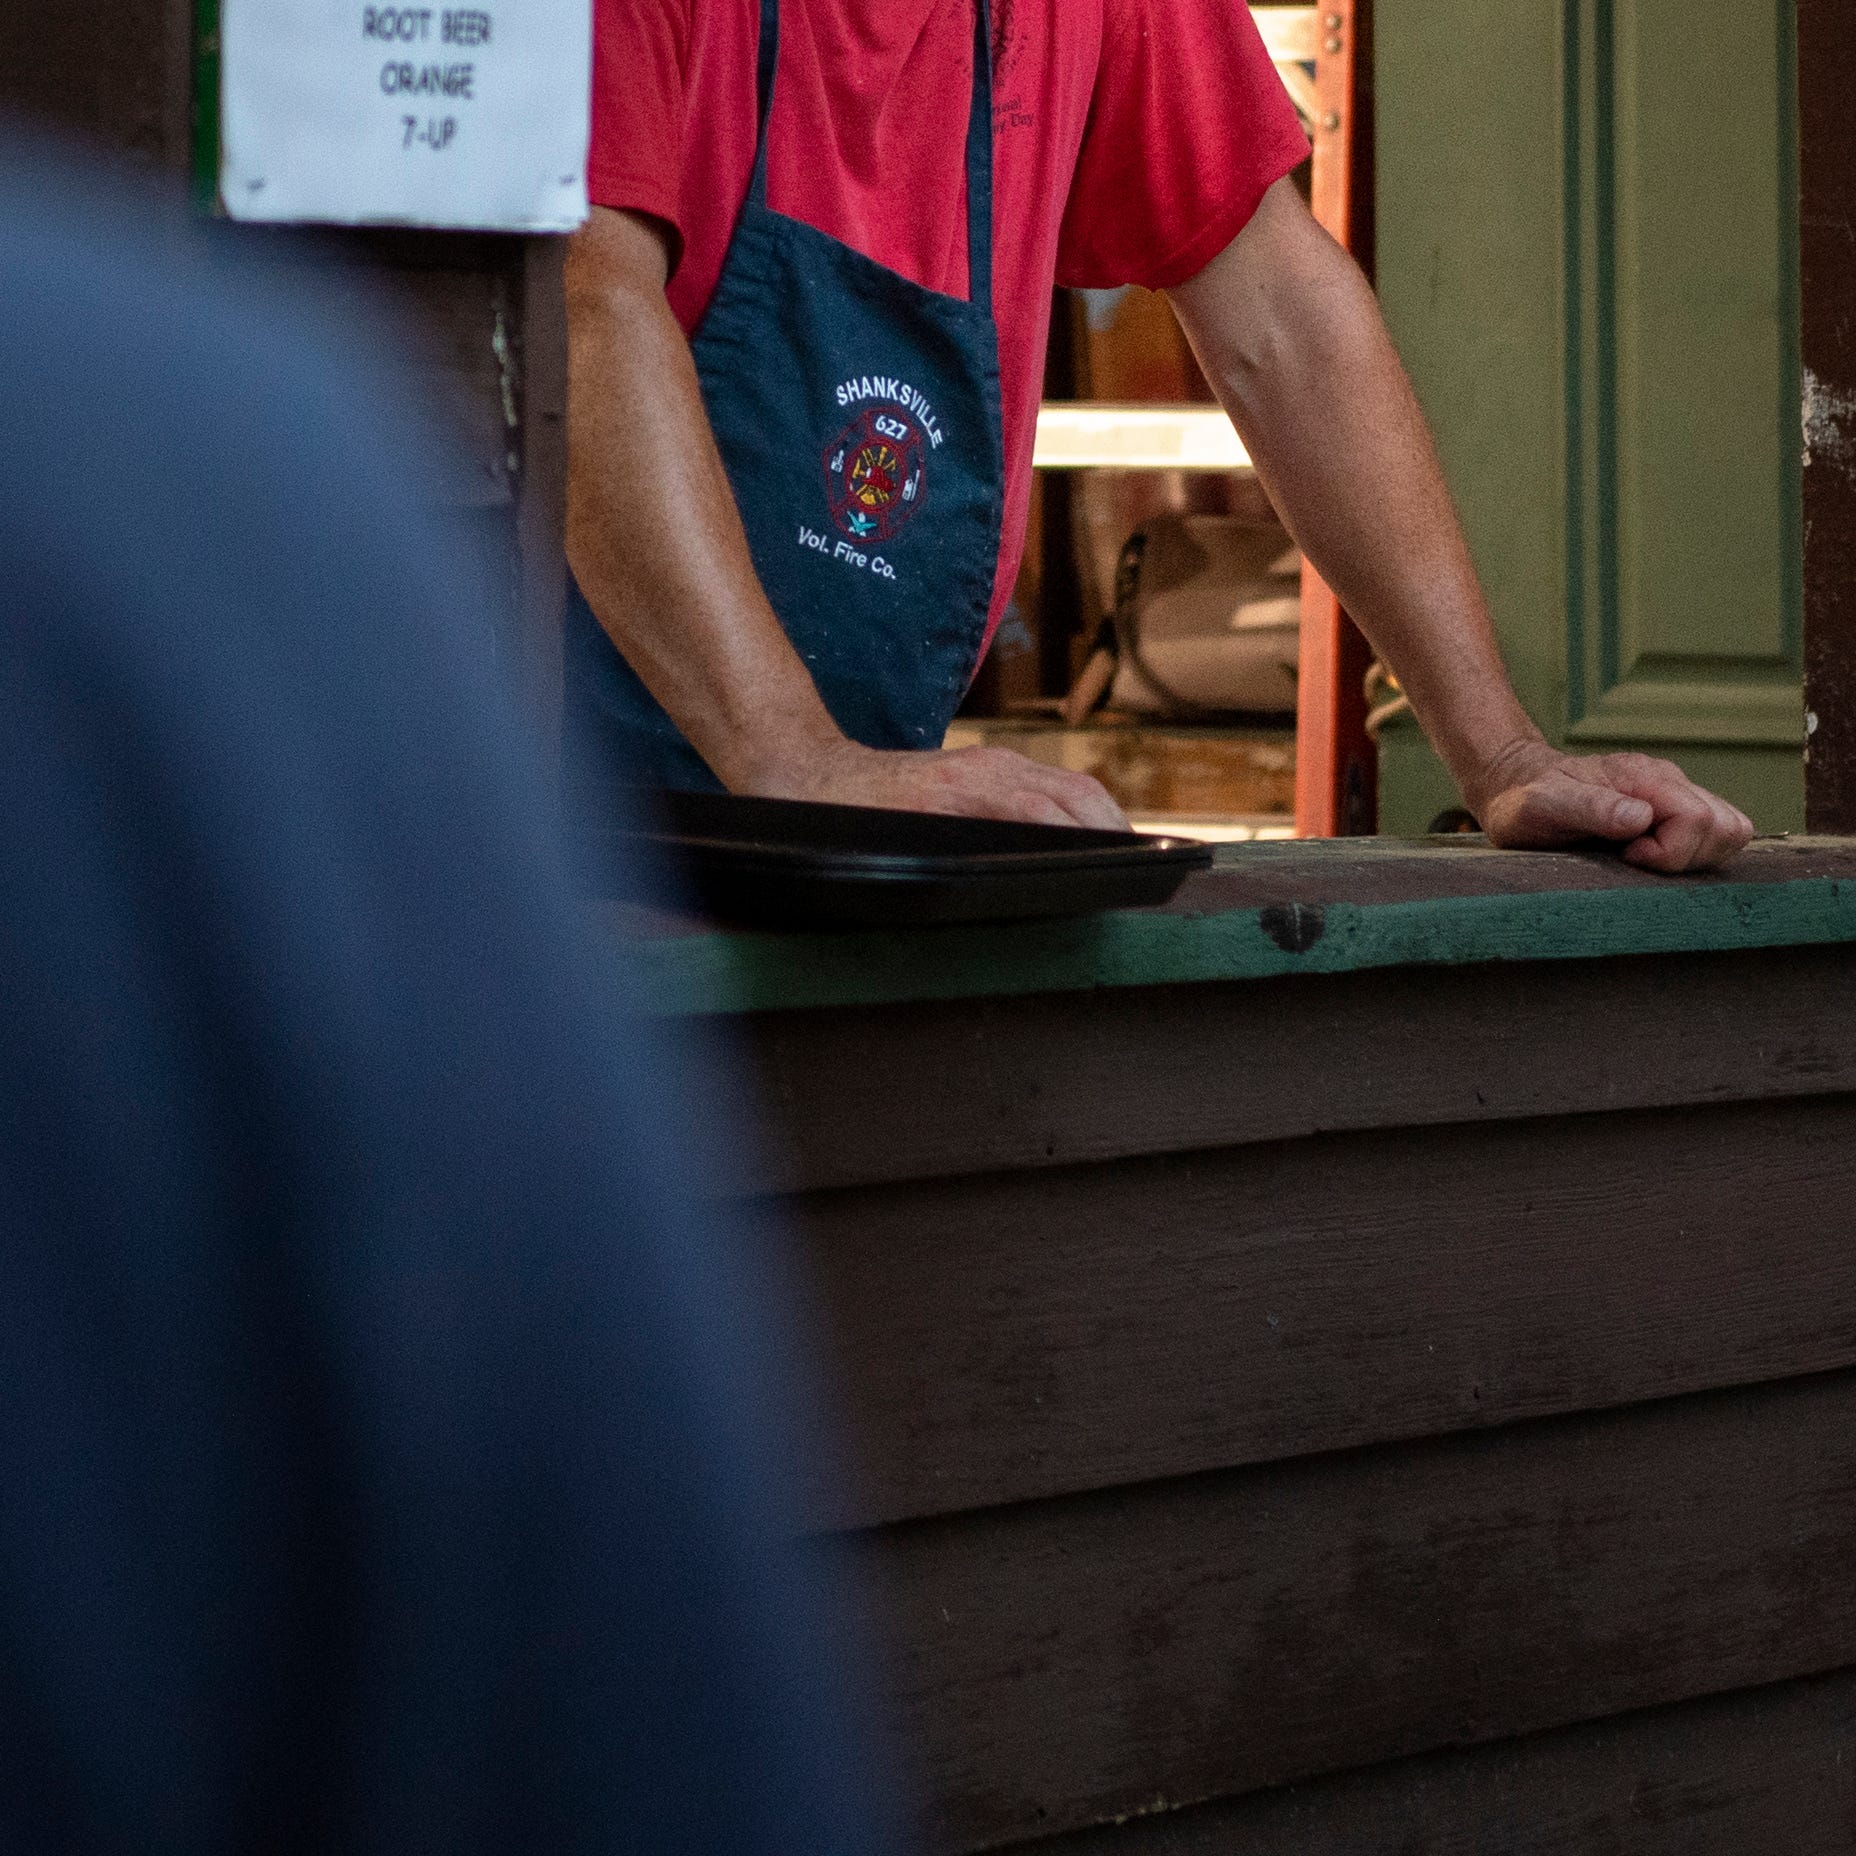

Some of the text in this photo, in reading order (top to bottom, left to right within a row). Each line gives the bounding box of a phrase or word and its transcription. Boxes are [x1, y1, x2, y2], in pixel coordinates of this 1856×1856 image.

[362, 6, 492, 46] ROOT BEER
[380, 61, 474, 100] ORANGE
[402, 114, 458, 150] 7-UP
[836, 376, 943, 449] SHANKSVILLE
[875, 415, 907, 440] 627
[798, 526, 897, 580] Vol. Fire Co.
